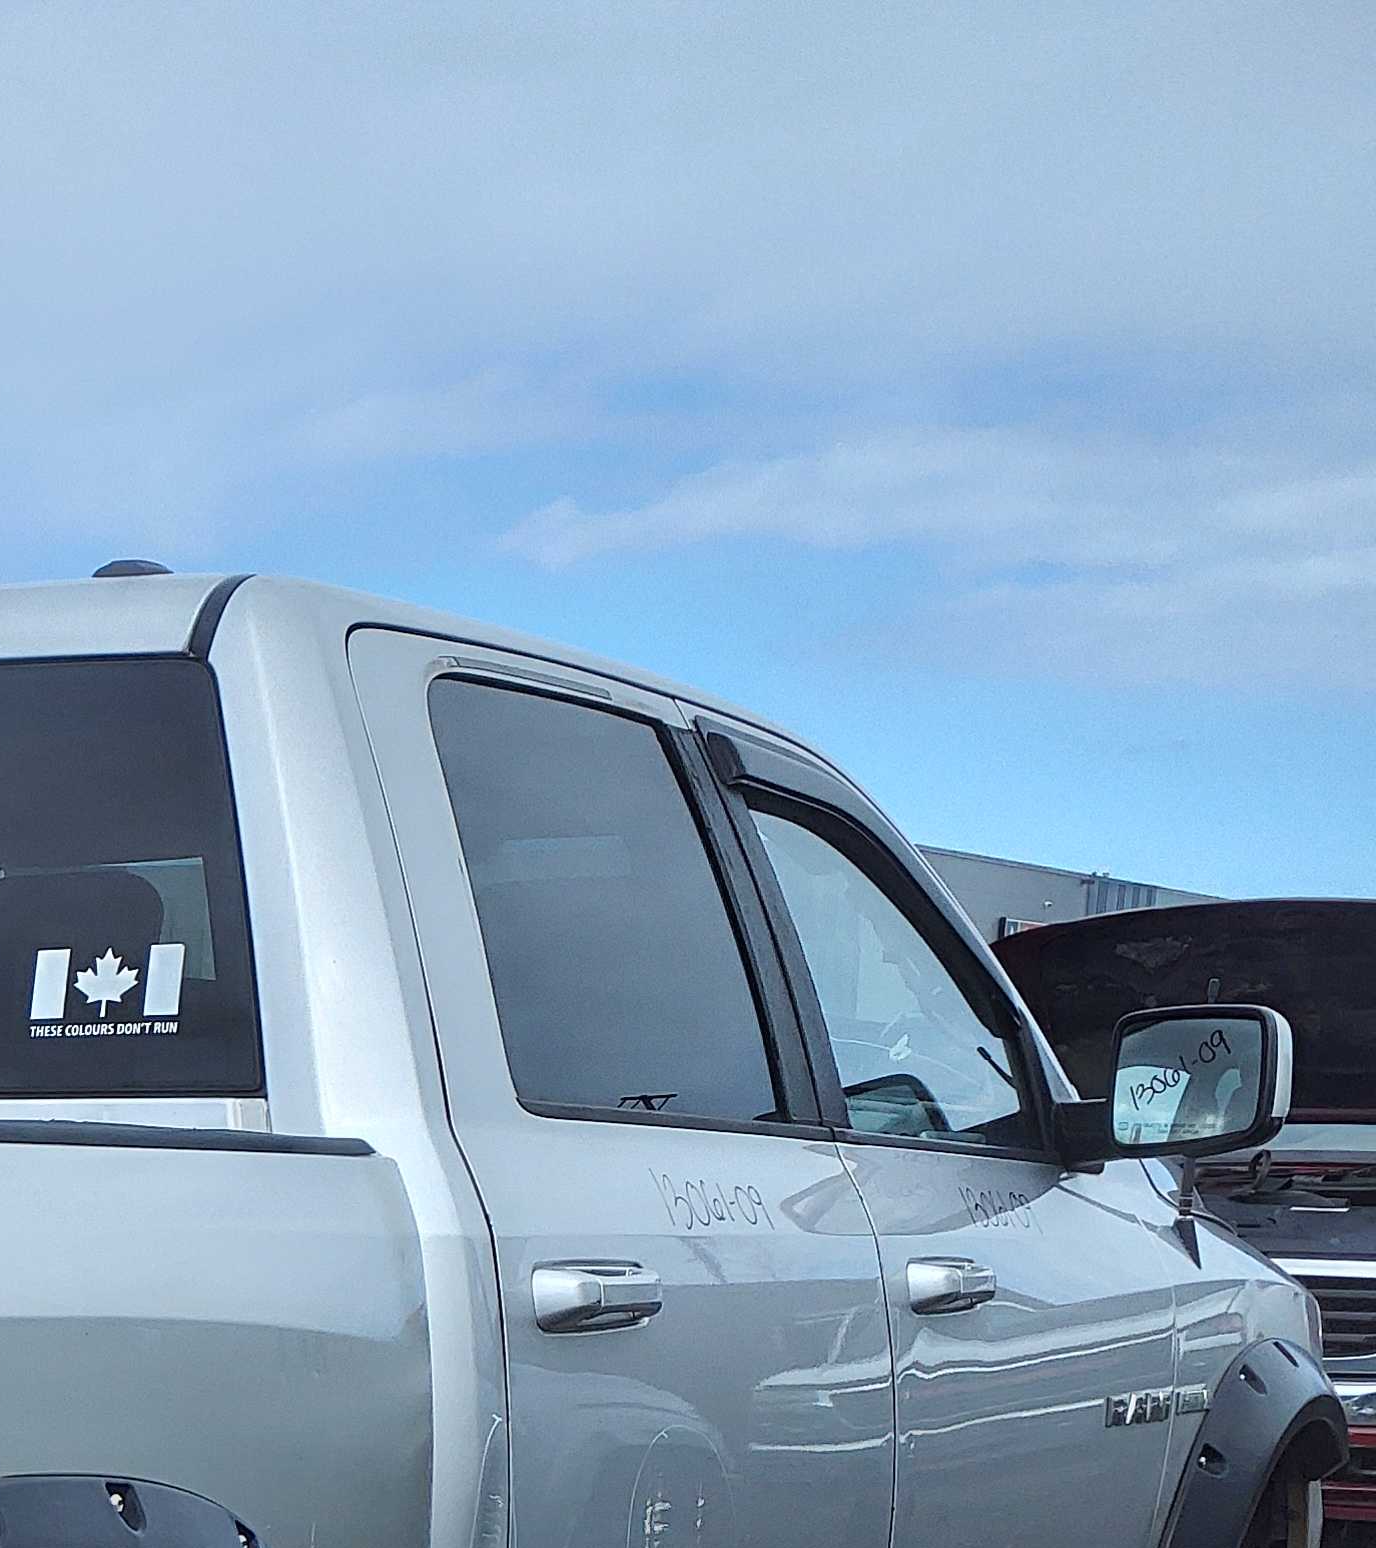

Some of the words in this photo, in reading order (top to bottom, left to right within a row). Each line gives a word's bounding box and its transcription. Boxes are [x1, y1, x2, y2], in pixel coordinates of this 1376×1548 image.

[30, 1025, 63, 1038] THESE
[65, 1023, 115, 1037] COLOURS
[116, 1021, 152, 1035] DON'T
[153, 1021, 179, 1034] RUN
[1129, 1029, 1232, 1111] 13061-09
[648, 1167, 776, 1231] 13061-09
